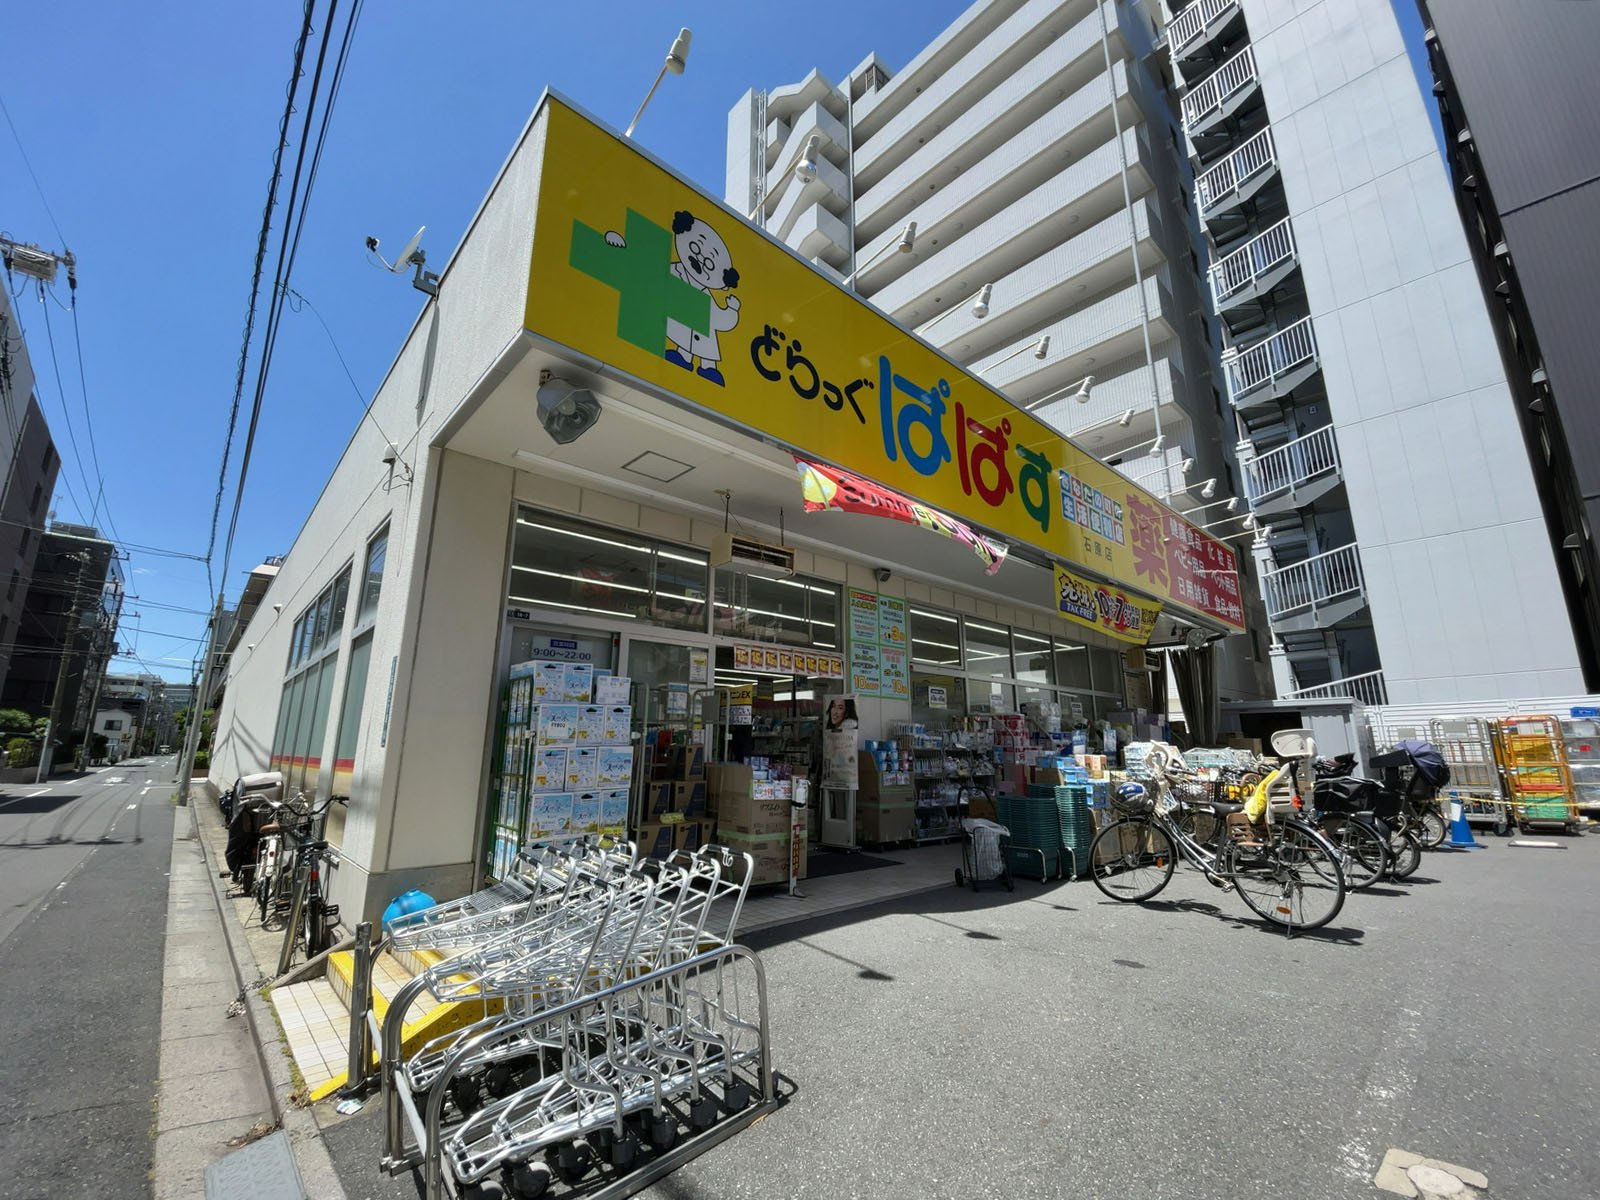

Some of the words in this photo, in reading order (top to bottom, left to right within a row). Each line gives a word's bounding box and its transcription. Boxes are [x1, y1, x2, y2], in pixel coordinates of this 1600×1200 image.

[751, 324, 875, 424] どらっぐ
[879, 355, 1052, 534] ぱぱす
[1083, 536, 1113, 562] 石原店
[1126, 493, 1169, 590] 薬
